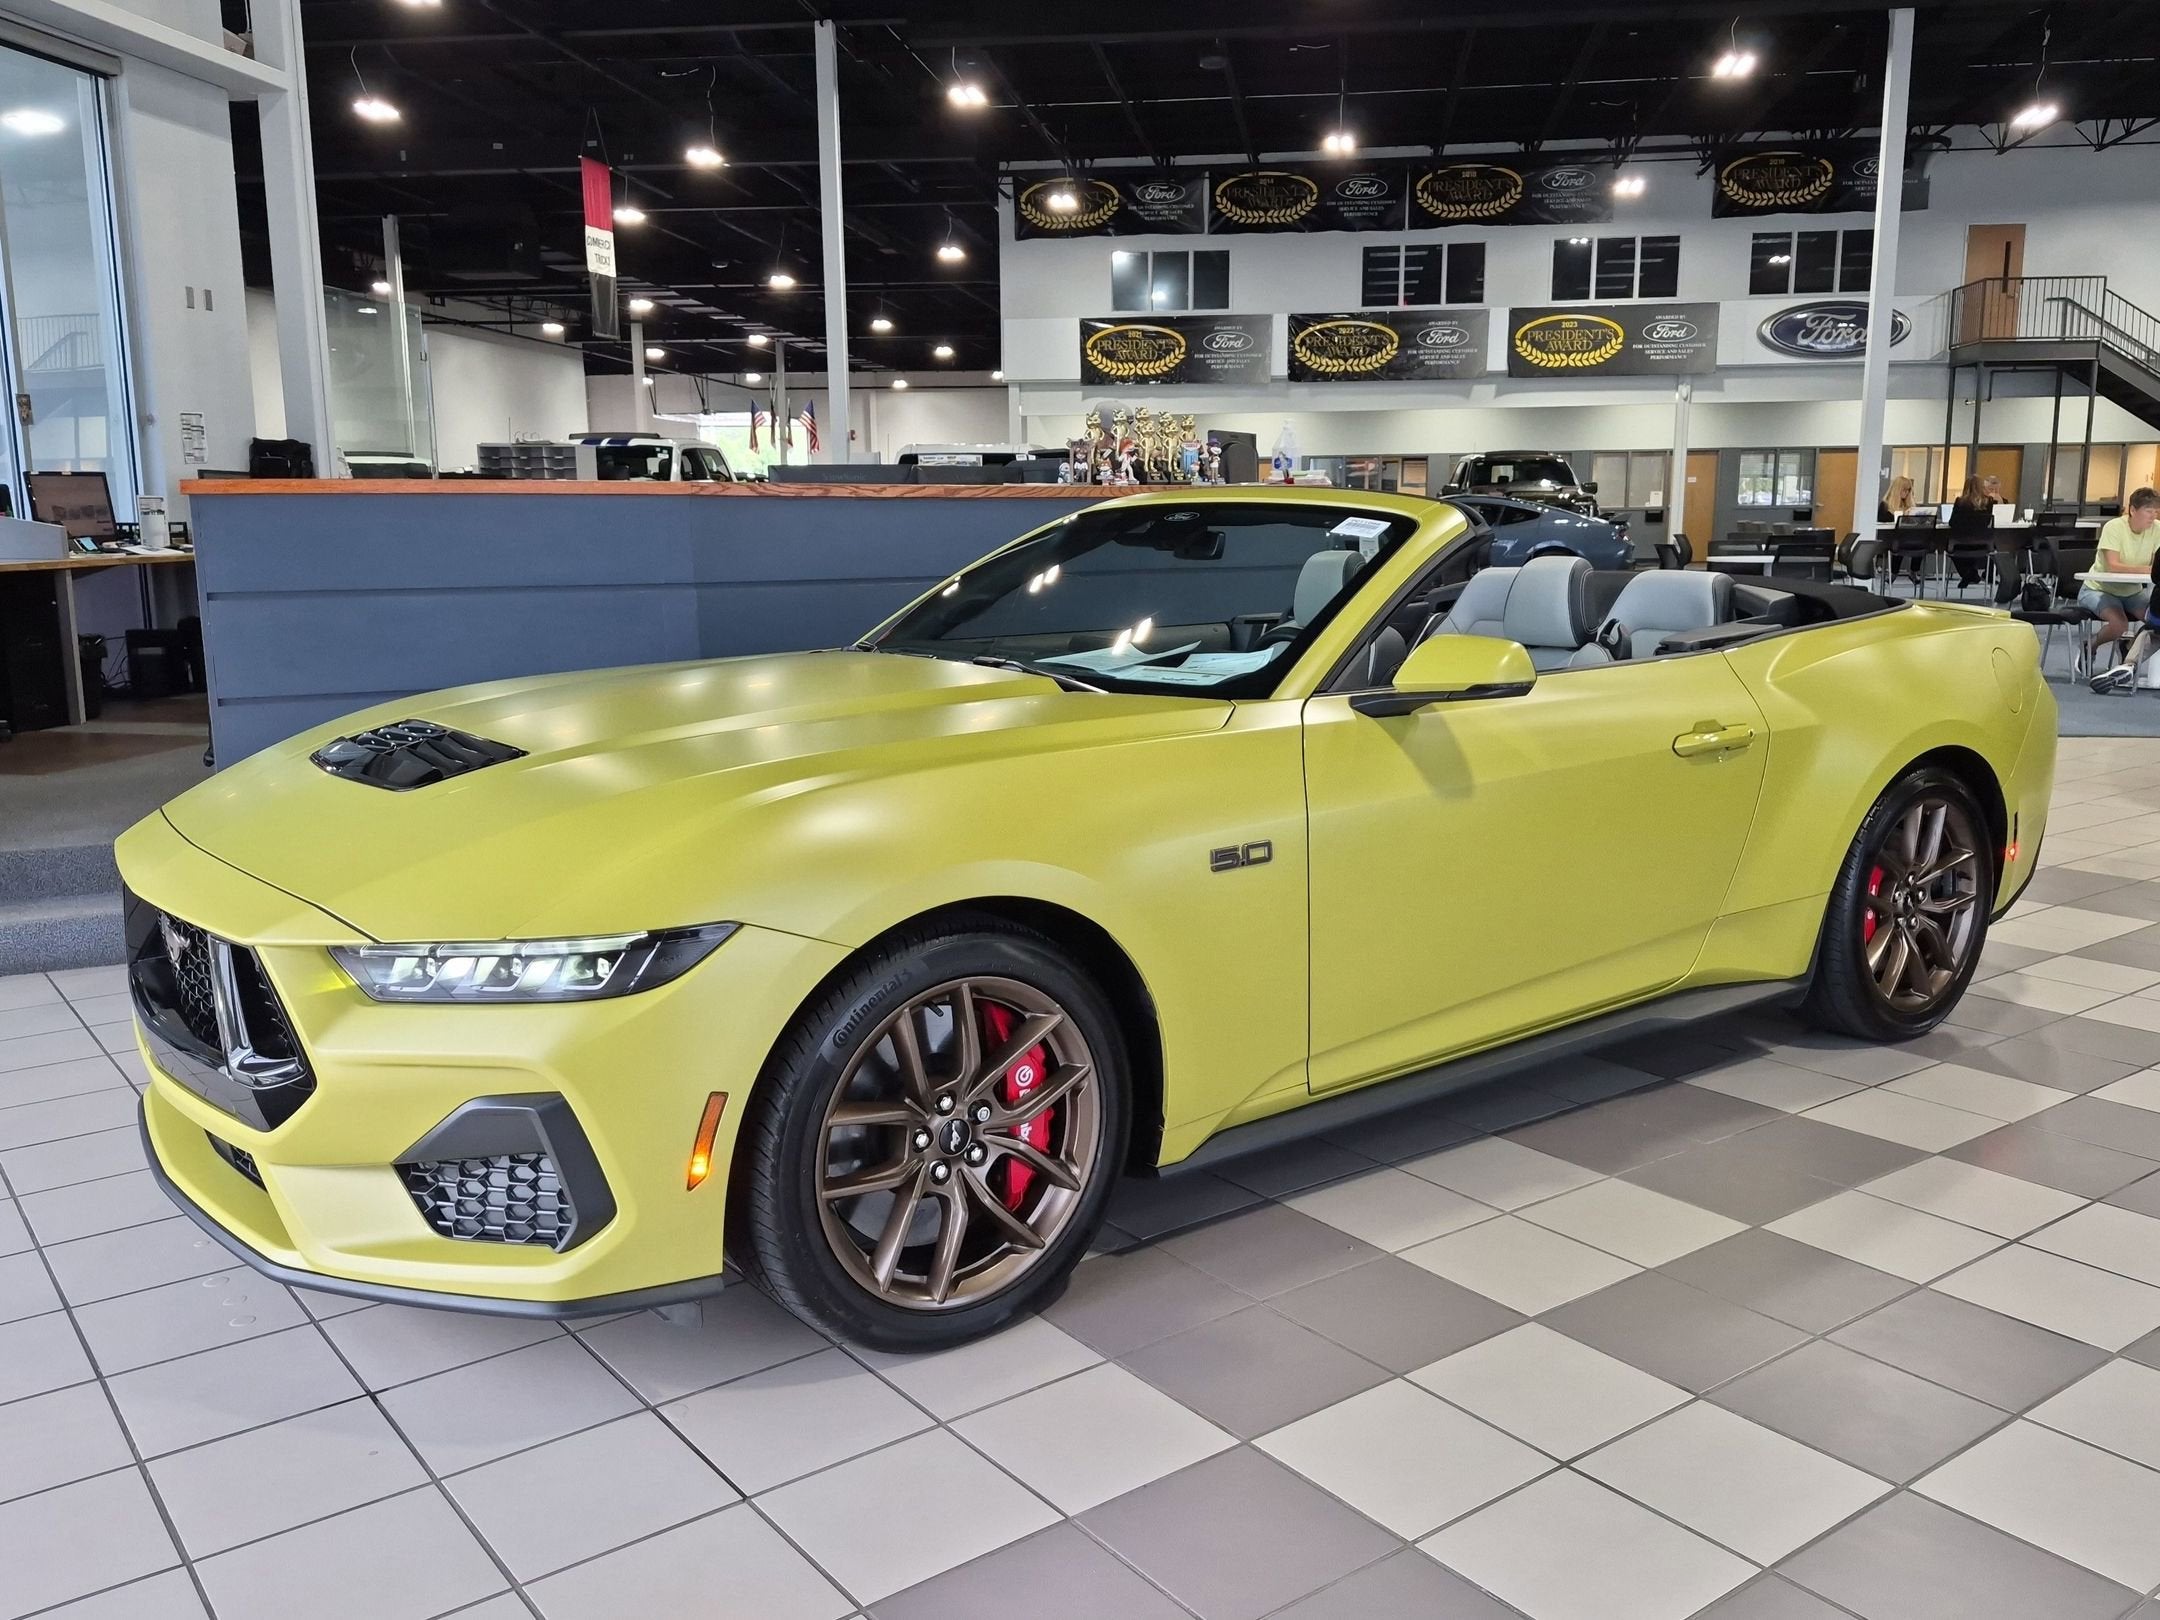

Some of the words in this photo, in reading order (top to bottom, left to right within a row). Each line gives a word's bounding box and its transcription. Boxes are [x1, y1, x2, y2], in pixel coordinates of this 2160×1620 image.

[1551, 171, 1587, 187] Ford
[1144, 185, 1177, 200] Ford
[1344, 180, 1379, 195] Ford
[1560, 320, 1578, 328] 2023
[1652, 323, 1688, 339] Ford
[1211, 334, 1245, 348] Ford
[1426, 329, 1460, 344] Ford
[1526, 327, 1615, 342] PRESIDENT'S
[1096, 339, 1177, 351] PRESIDENT'S
[1327, 345, 1371, 358] AWARD
[1543, 339, 1594, 352] AWARD
[1114, 347, 1158, 360] AWARD
[1209, 839, 1273, 873] 5.0
[832, 973, 903, 1049] Continental
